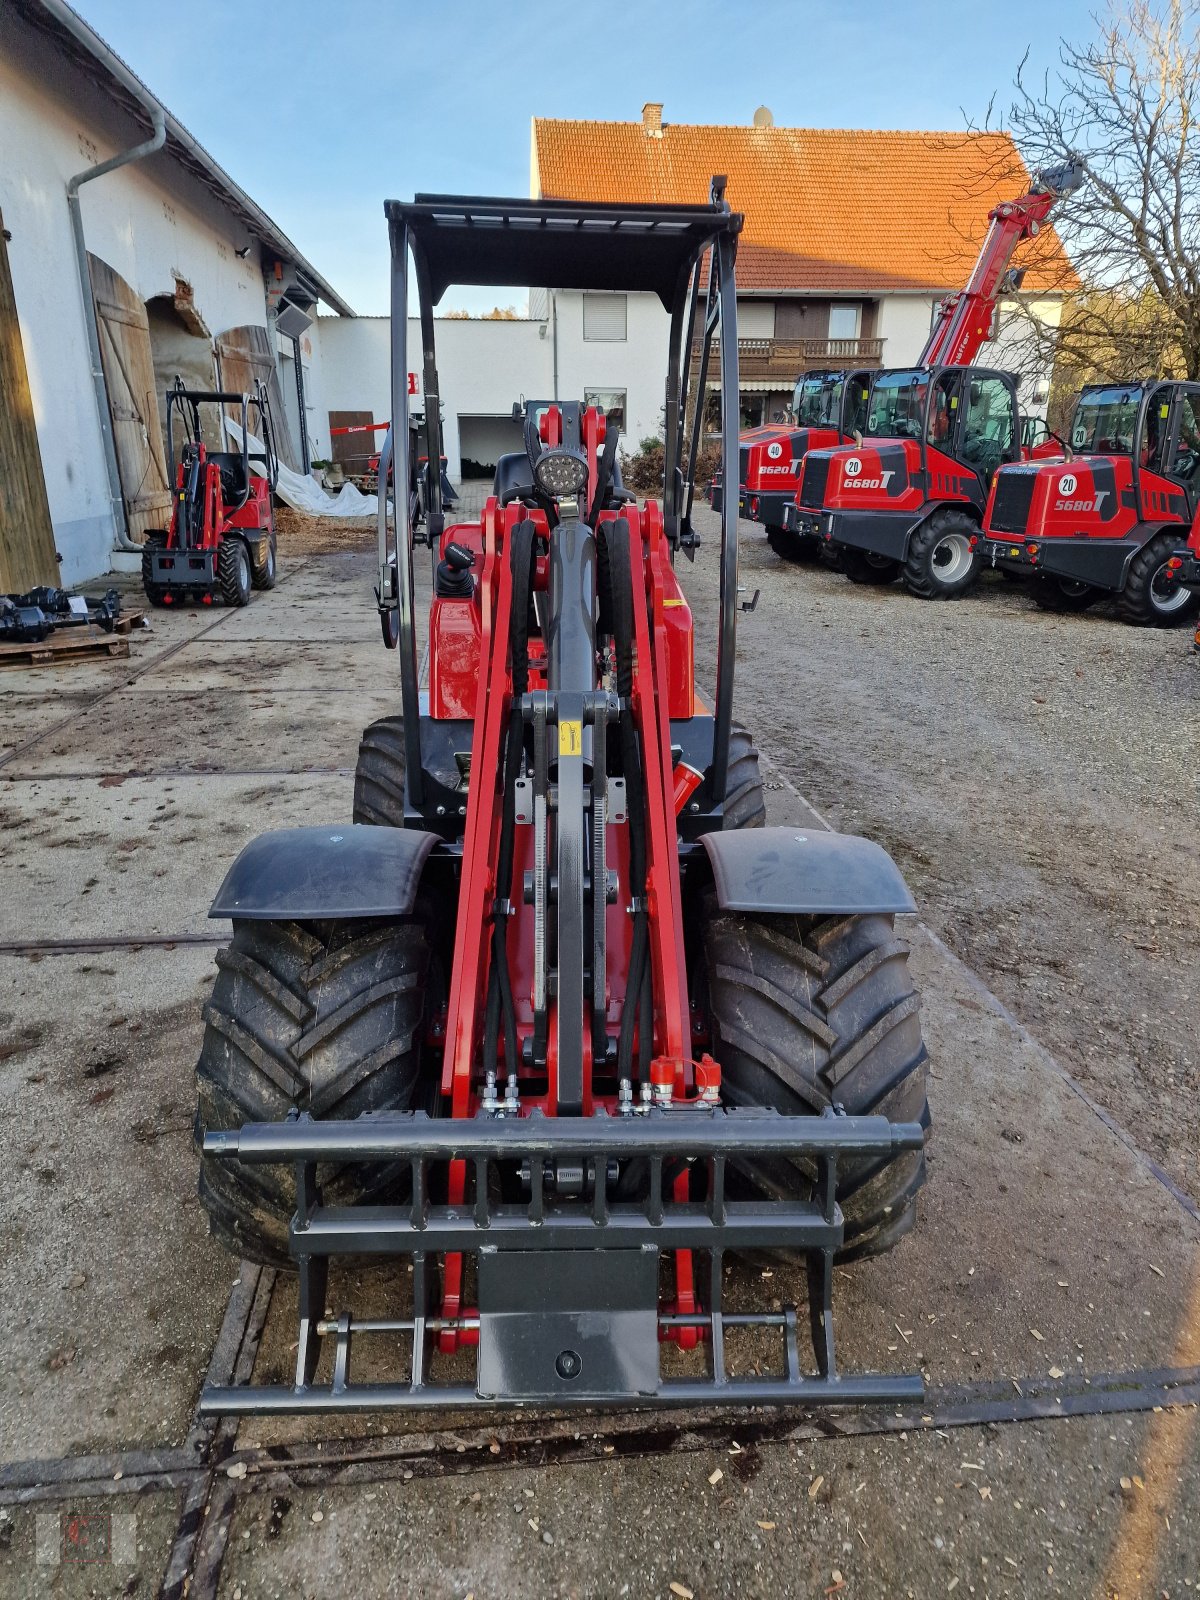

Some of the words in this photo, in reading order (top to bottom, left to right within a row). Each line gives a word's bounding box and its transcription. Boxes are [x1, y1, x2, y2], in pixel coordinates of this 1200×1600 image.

[1075, 430, 1085, 443] 20
[771, 446, 780, 456] 40
[848, 461, 859, 473] 20
[843, 470, 896, 489] 6680T
[1062, 478, 1074, 492] 20
[1054, 491, 1111, 512] 5680T
